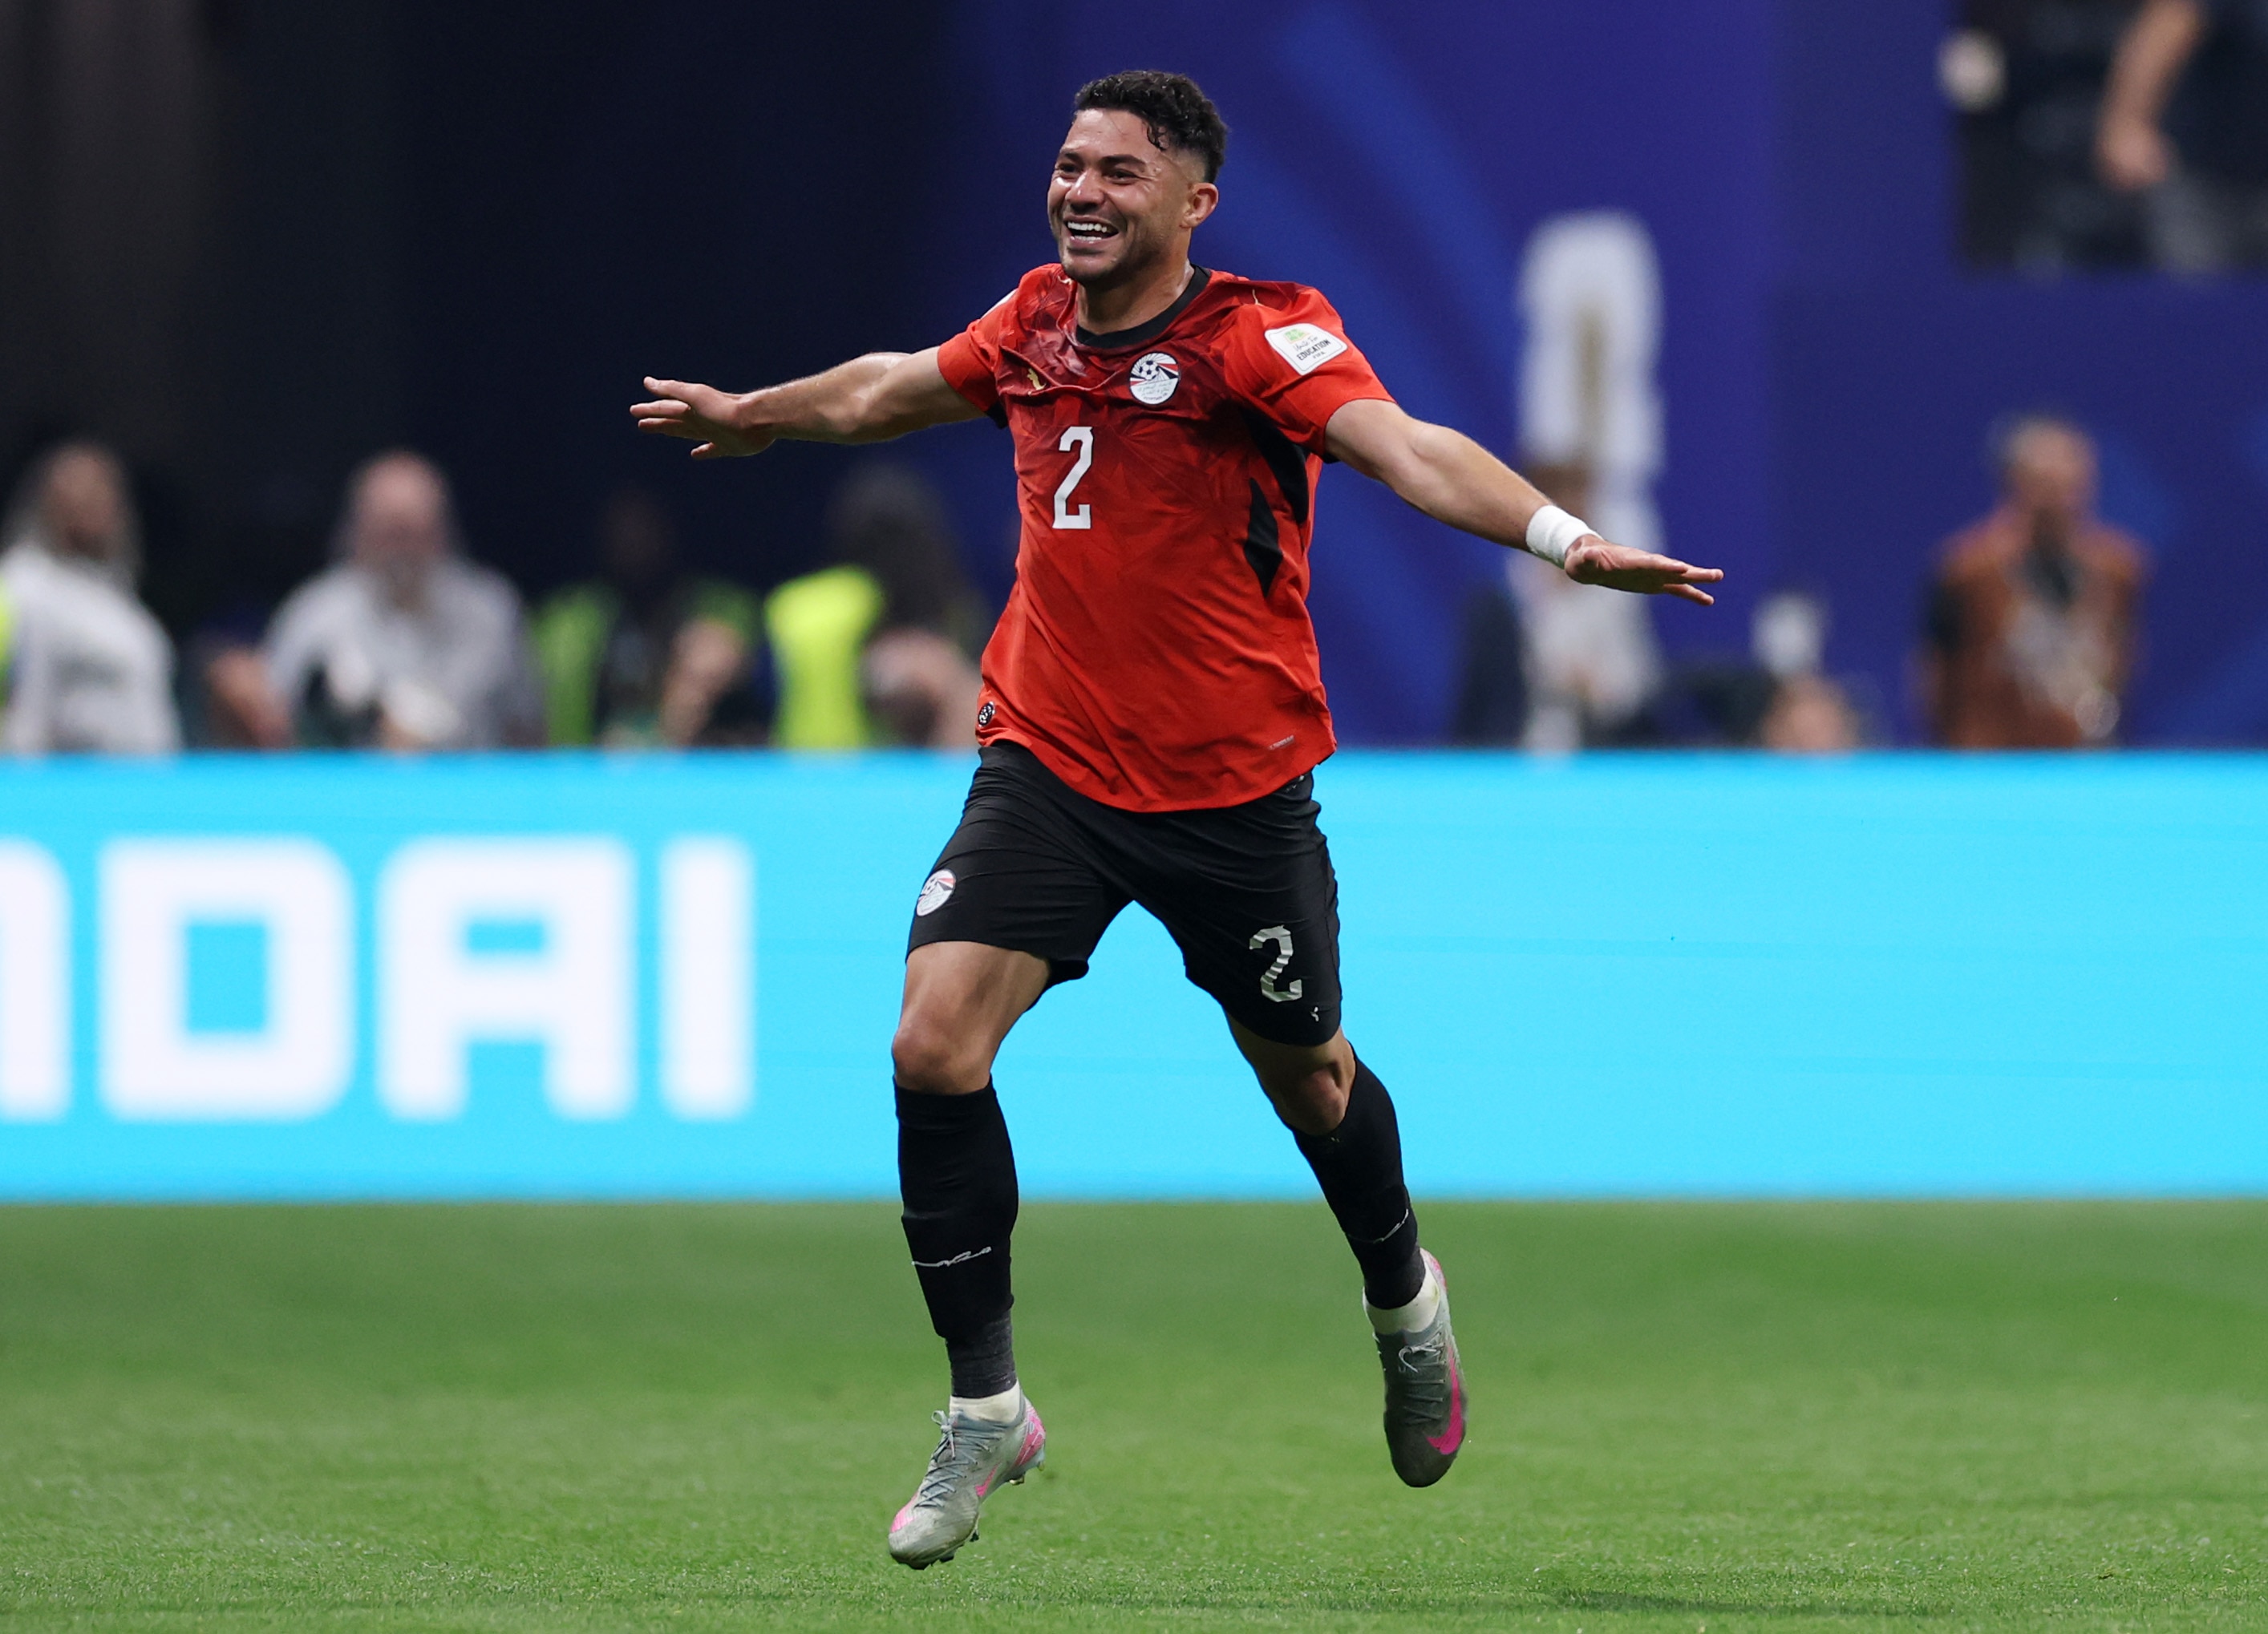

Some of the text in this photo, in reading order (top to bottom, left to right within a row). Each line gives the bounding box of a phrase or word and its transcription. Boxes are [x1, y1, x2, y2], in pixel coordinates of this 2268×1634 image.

[1296, 338, 1331, 361] EDUCATION
[1052, 426, 1094, 529] 2
[0, 834, 756, 1121] DAI
[1249, 924, 1302, 1003] 2
